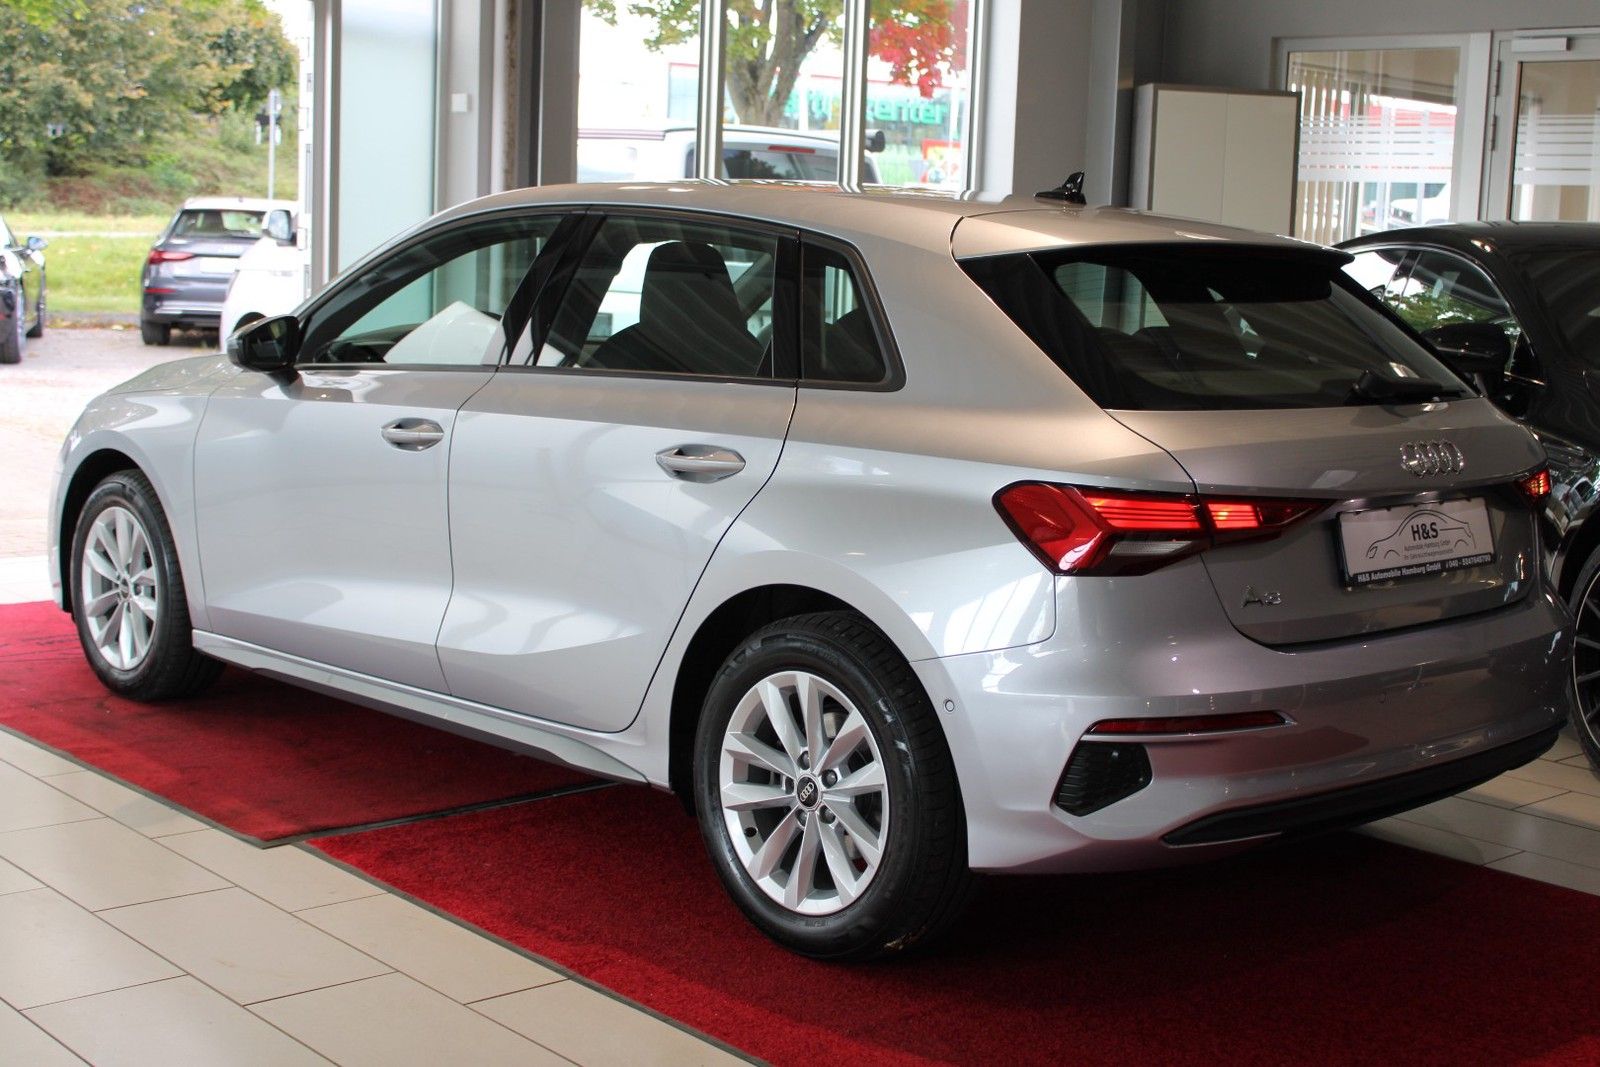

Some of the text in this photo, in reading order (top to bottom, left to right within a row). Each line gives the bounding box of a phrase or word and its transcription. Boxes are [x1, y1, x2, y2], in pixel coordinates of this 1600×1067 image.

[1411, 522, 1439, 541] H&S
[1357, 574, 1370, 582] H&S
[1371, 570, 1401, 580] Automobile
[1401, 566, 1425, 576] Hamburg
[1426, 562, 1441, 571] GmbH
